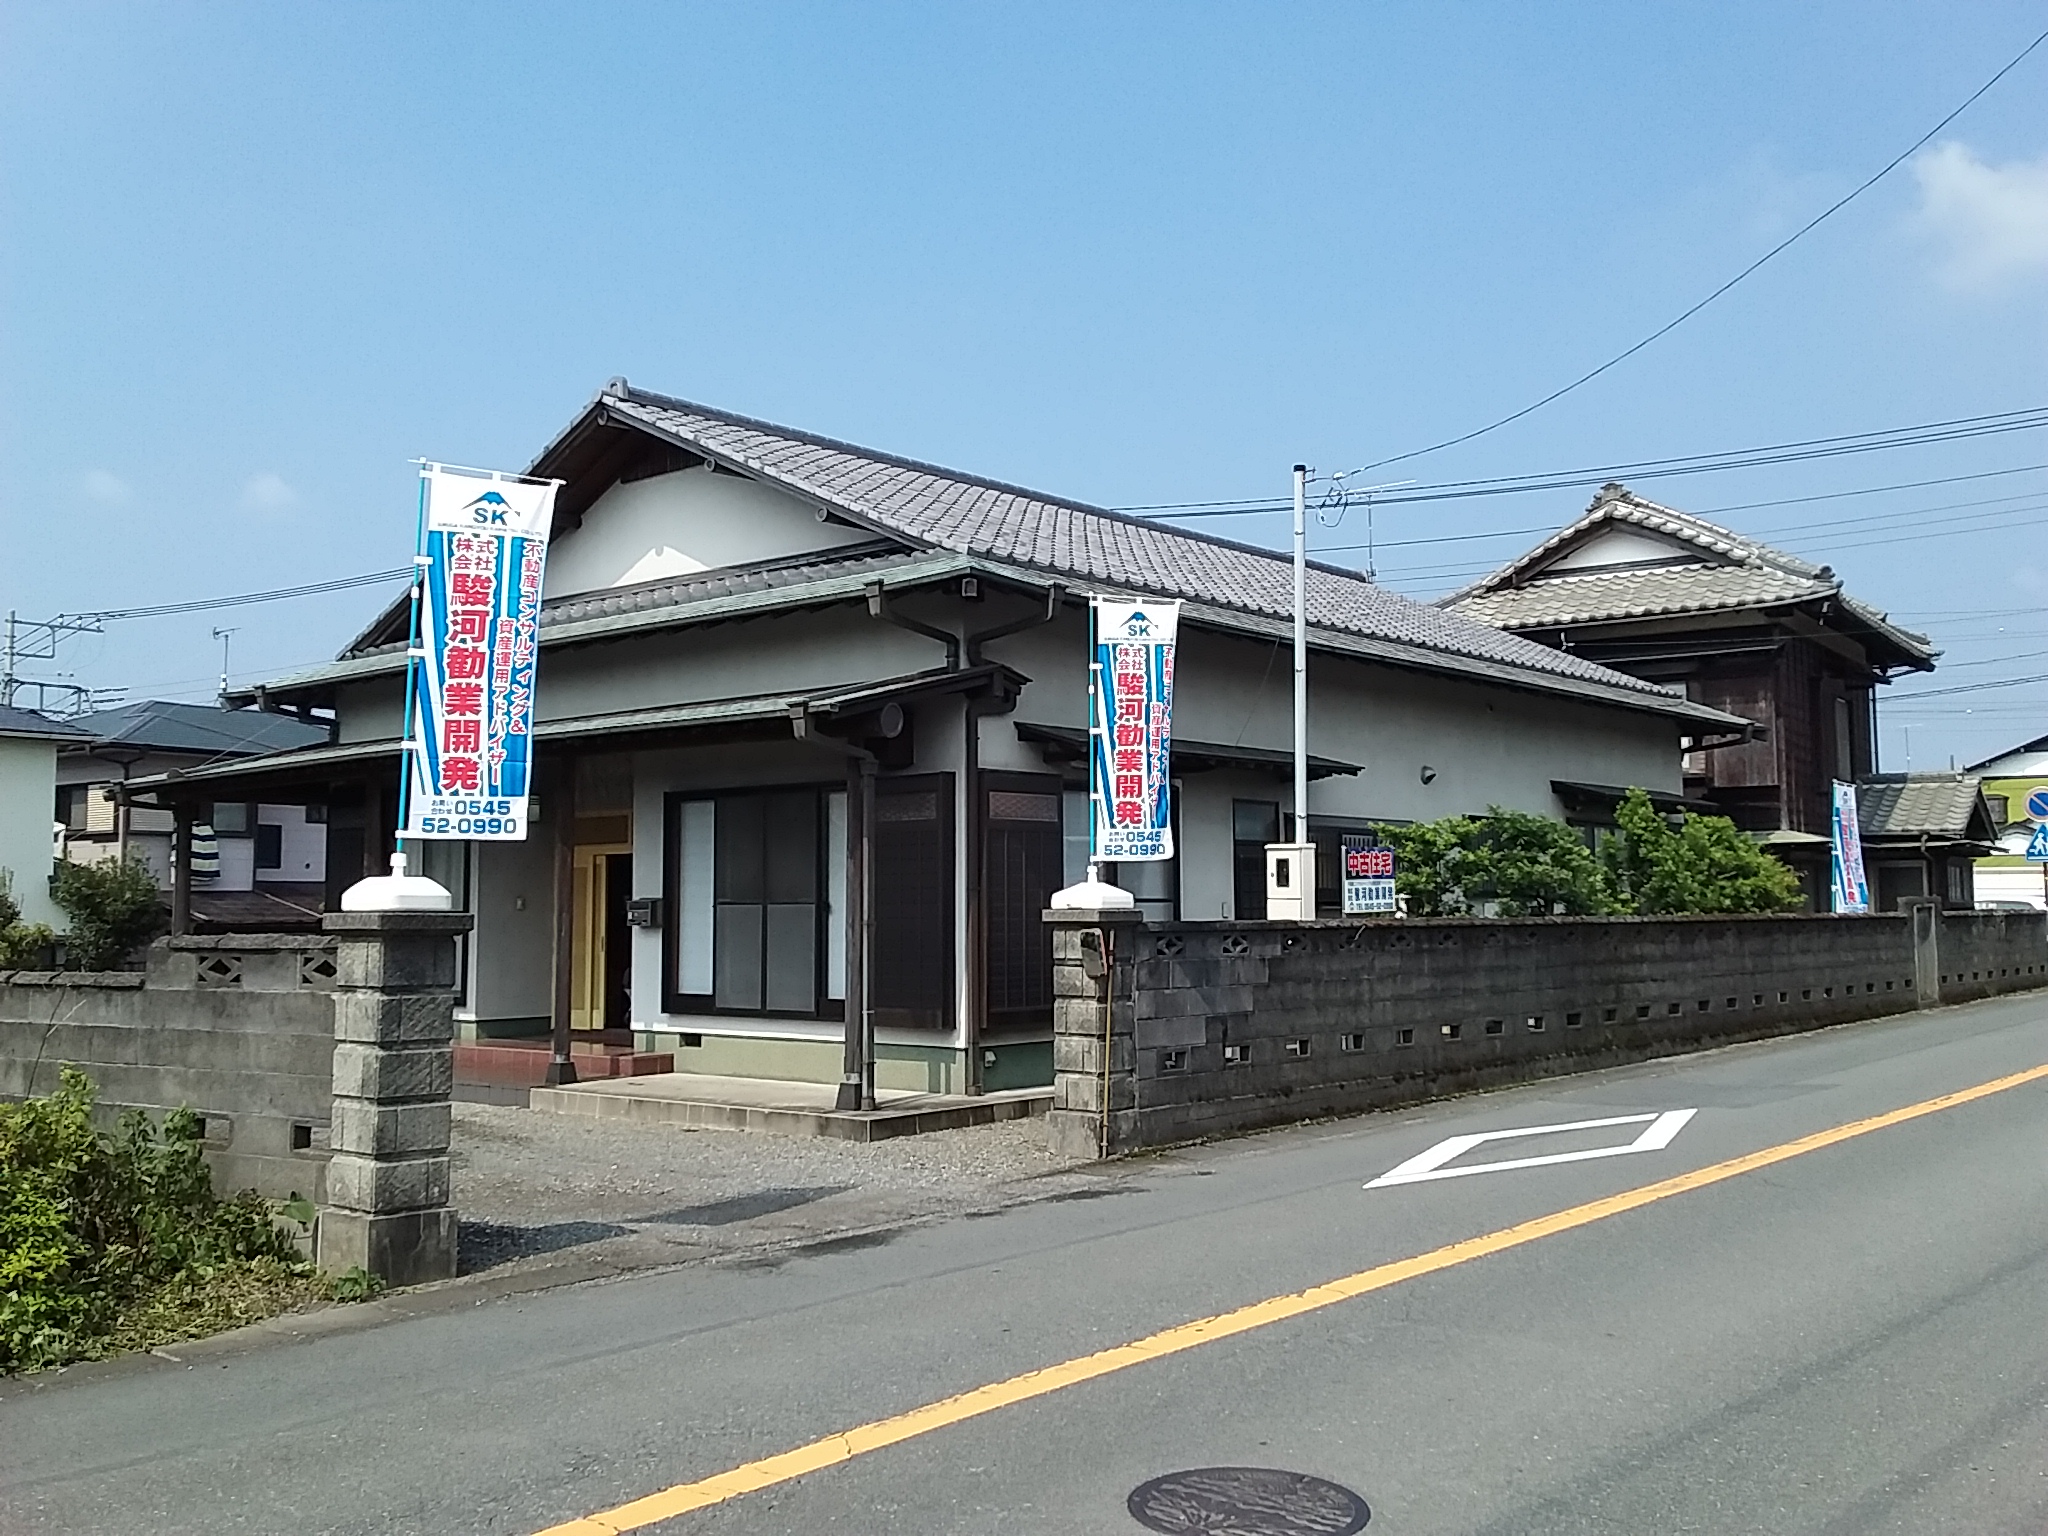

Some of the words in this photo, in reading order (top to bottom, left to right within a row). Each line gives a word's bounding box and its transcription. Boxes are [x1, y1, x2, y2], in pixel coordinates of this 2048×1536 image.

[472, 507, 509, 526] SK
[455, 536, 495, 555] 株式
[454, 554, 493, 571] 会社
[511, 543, 545, 733] 不動産コンサルティング&
[1127, 624, 1151, 637] SK
[1118, 647, 1144, 658] 株式
[1118, 659, 1143, 670] 会社
[441, 573, 494, 790] 駿河勧業開発
[489, 619, 515, 784] 資産運用アドバイザー
[1115, 672, 1145, 825] 駿河勧業開発
[454, 799, 511, 816] 0545
[421, 817, 517, 835] 52-0990
[1125, 831, 1162, 842] 0545
[1104, 843, 1166, 856] 52-0990
[1348, 852, 1391, 874] 中古住宅
